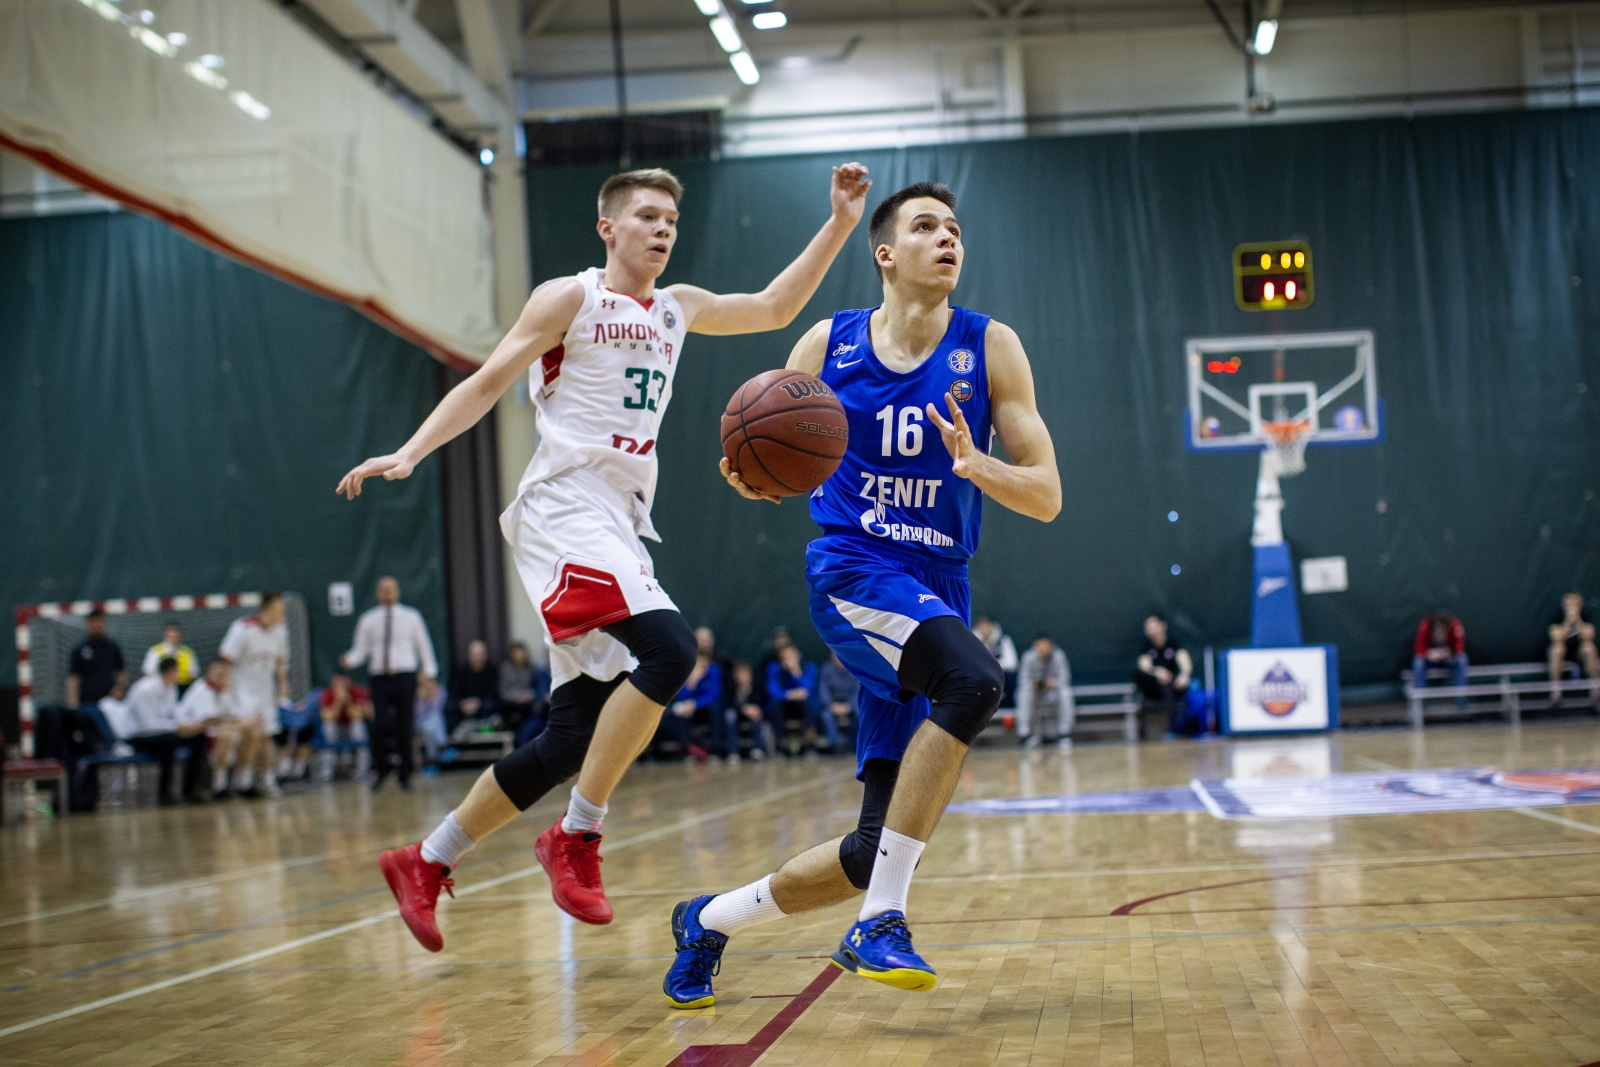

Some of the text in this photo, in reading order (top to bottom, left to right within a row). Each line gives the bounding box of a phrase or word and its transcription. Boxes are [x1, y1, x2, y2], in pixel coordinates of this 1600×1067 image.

[623, 367, 667, 414] 33
[780, 379, 836, 400] Wil
[795, 421, 848, 440] SOLUT
[876, 404, 924, 457] 16
[859, 471, 943, 508] ZENIT
[890, 523, 954, 547] GAZPROM
